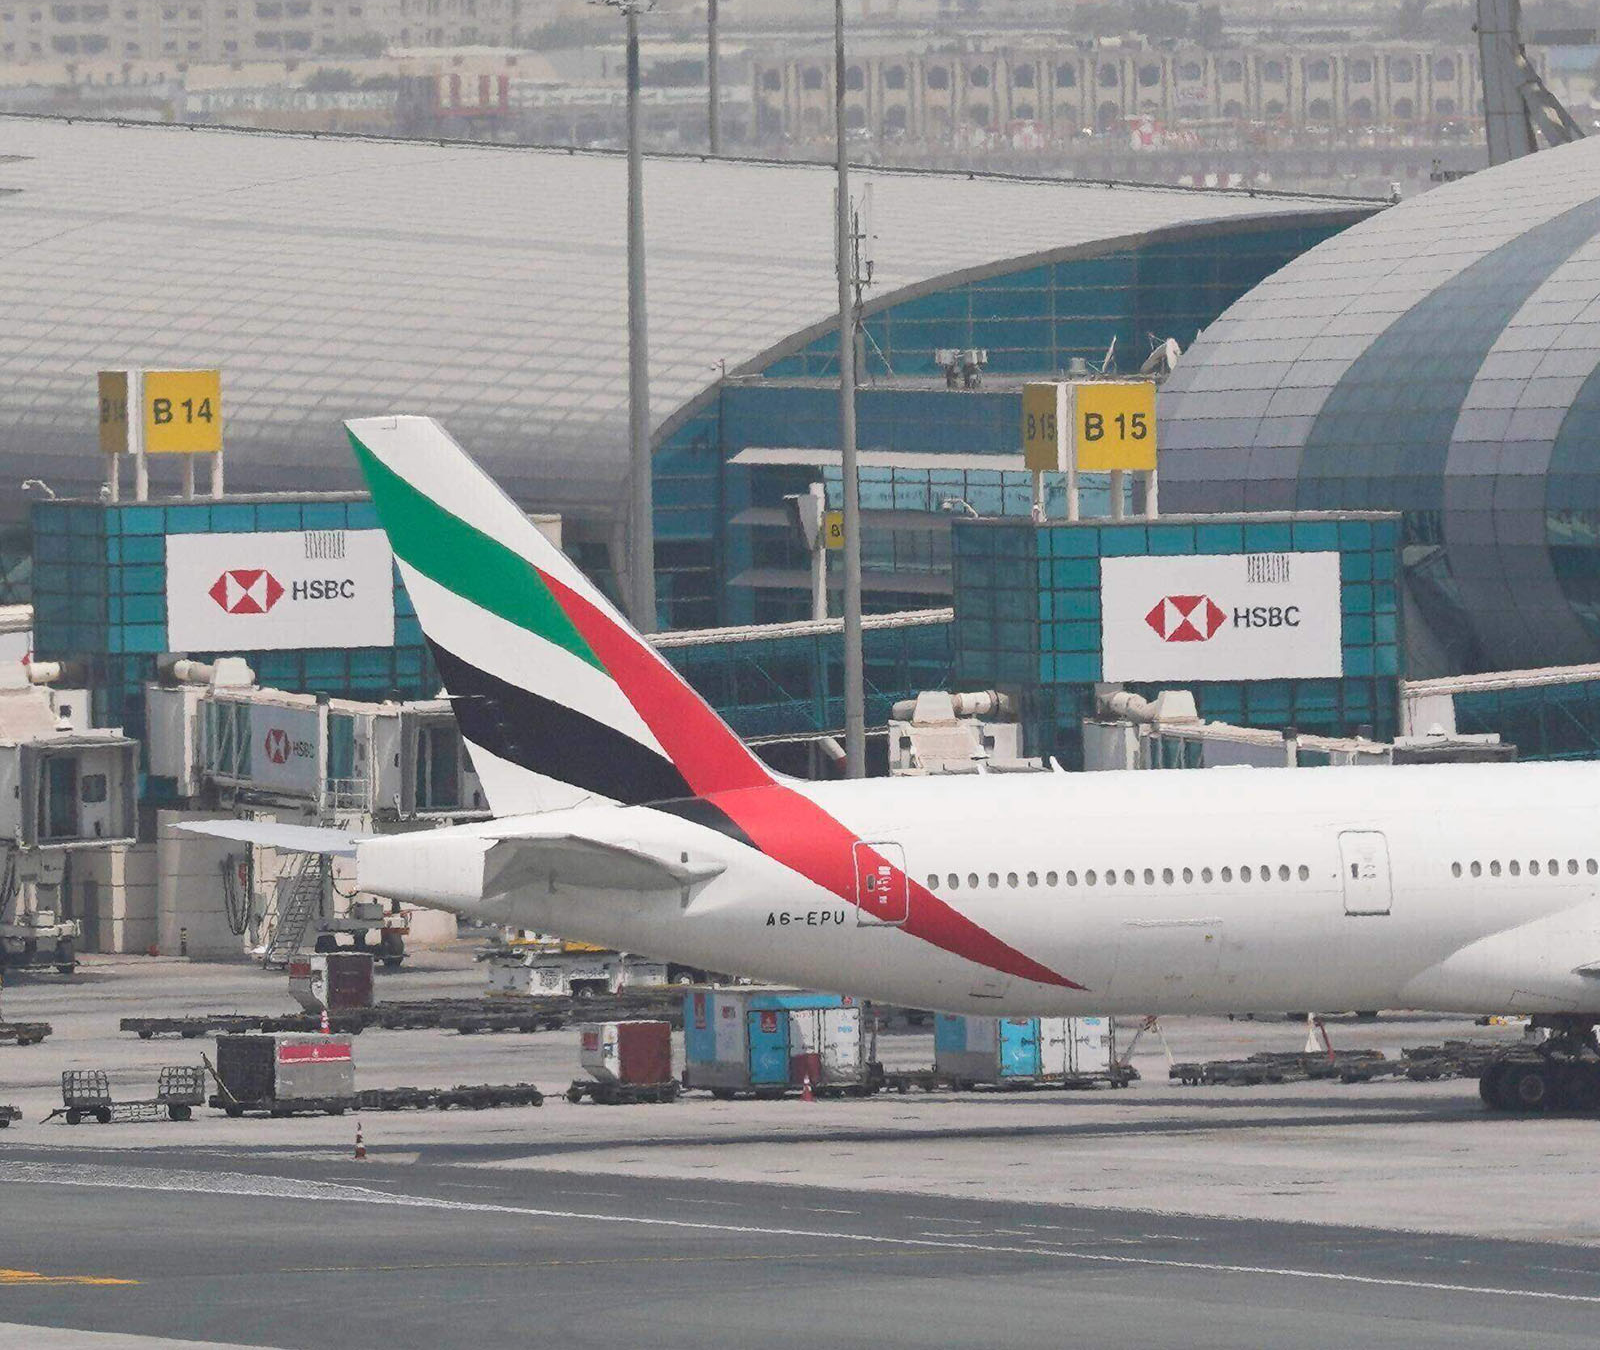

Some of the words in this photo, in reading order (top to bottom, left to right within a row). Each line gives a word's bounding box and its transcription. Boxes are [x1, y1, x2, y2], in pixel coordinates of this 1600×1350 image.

[153, 398, 173, 425] B
[182, 397, 213, 424] 14
[1085, 412, 1104, 441] B
[1114, 412, 1148, 440] 15
[292, 579, 355, 601] HSBC
[1232, 605, 1301, 628] HSBC
[765, 910, 845, 928] A6-EPU
